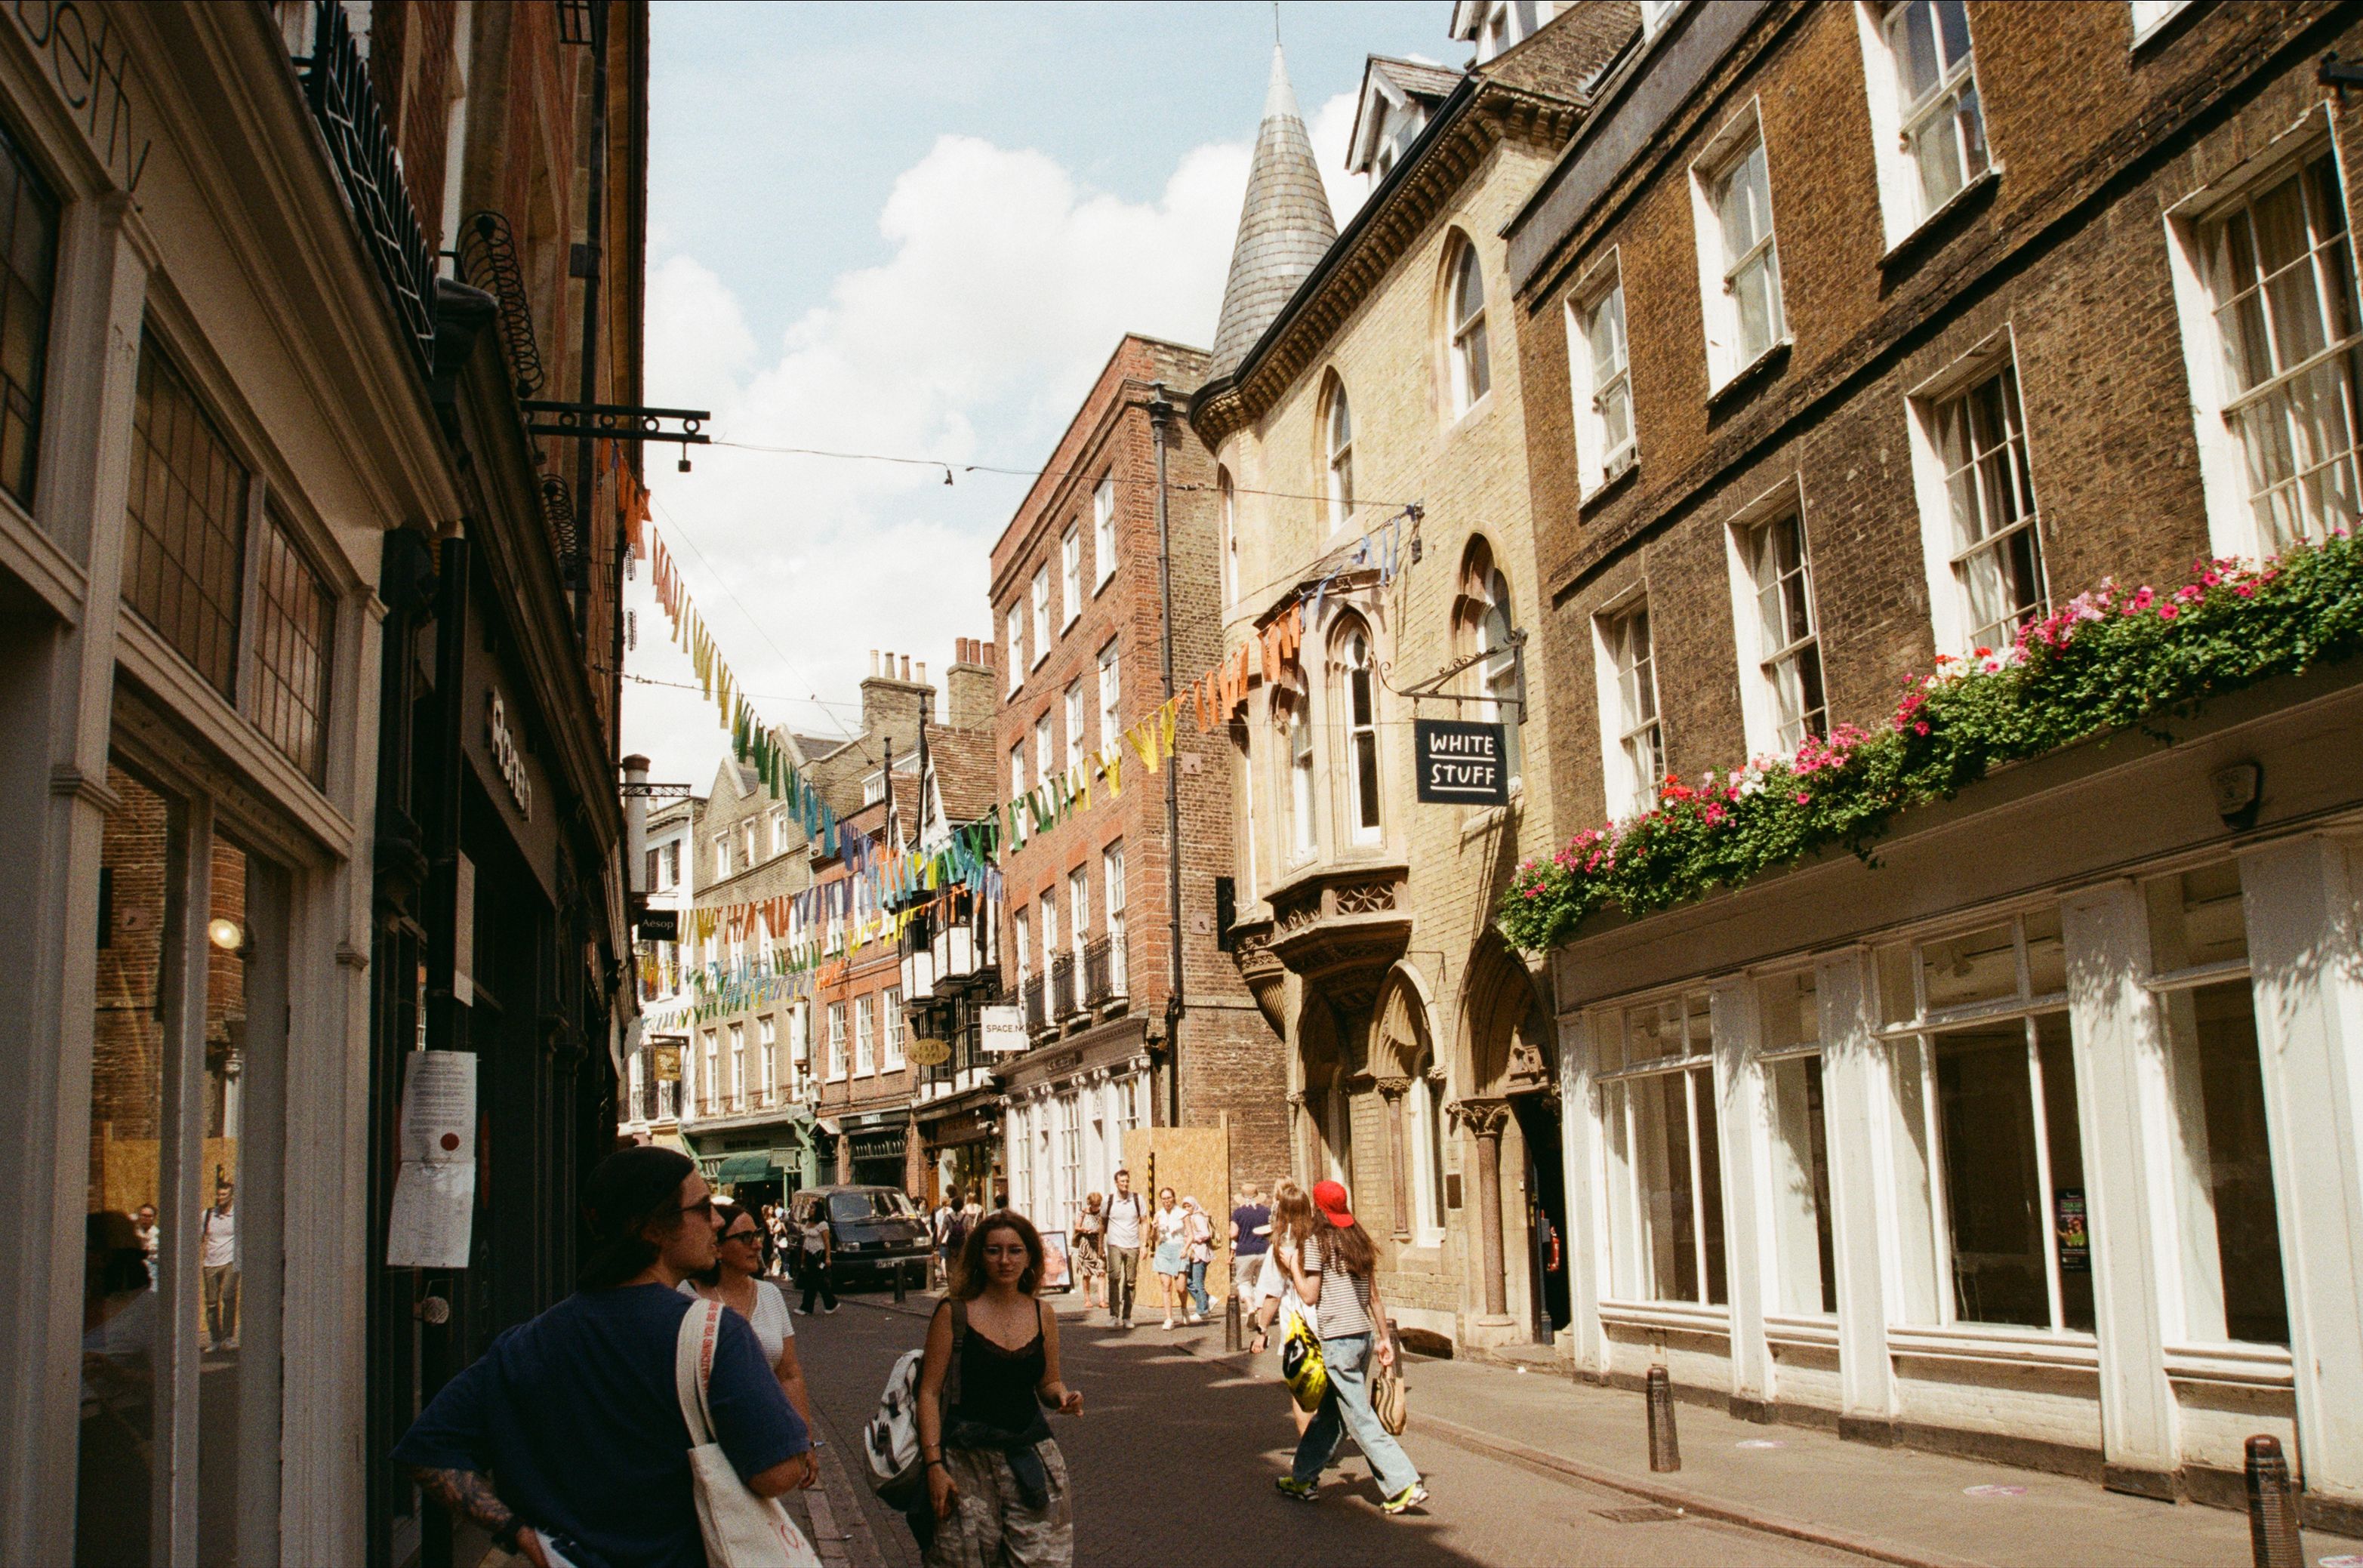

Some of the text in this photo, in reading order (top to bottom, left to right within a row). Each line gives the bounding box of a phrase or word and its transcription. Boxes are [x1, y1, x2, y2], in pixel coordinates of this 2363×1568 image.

[1430, 732, 1494, 755] WHITE
[1431, 763, 1496, 785] STUFF
[642, 919, 674, 930] Aesop
